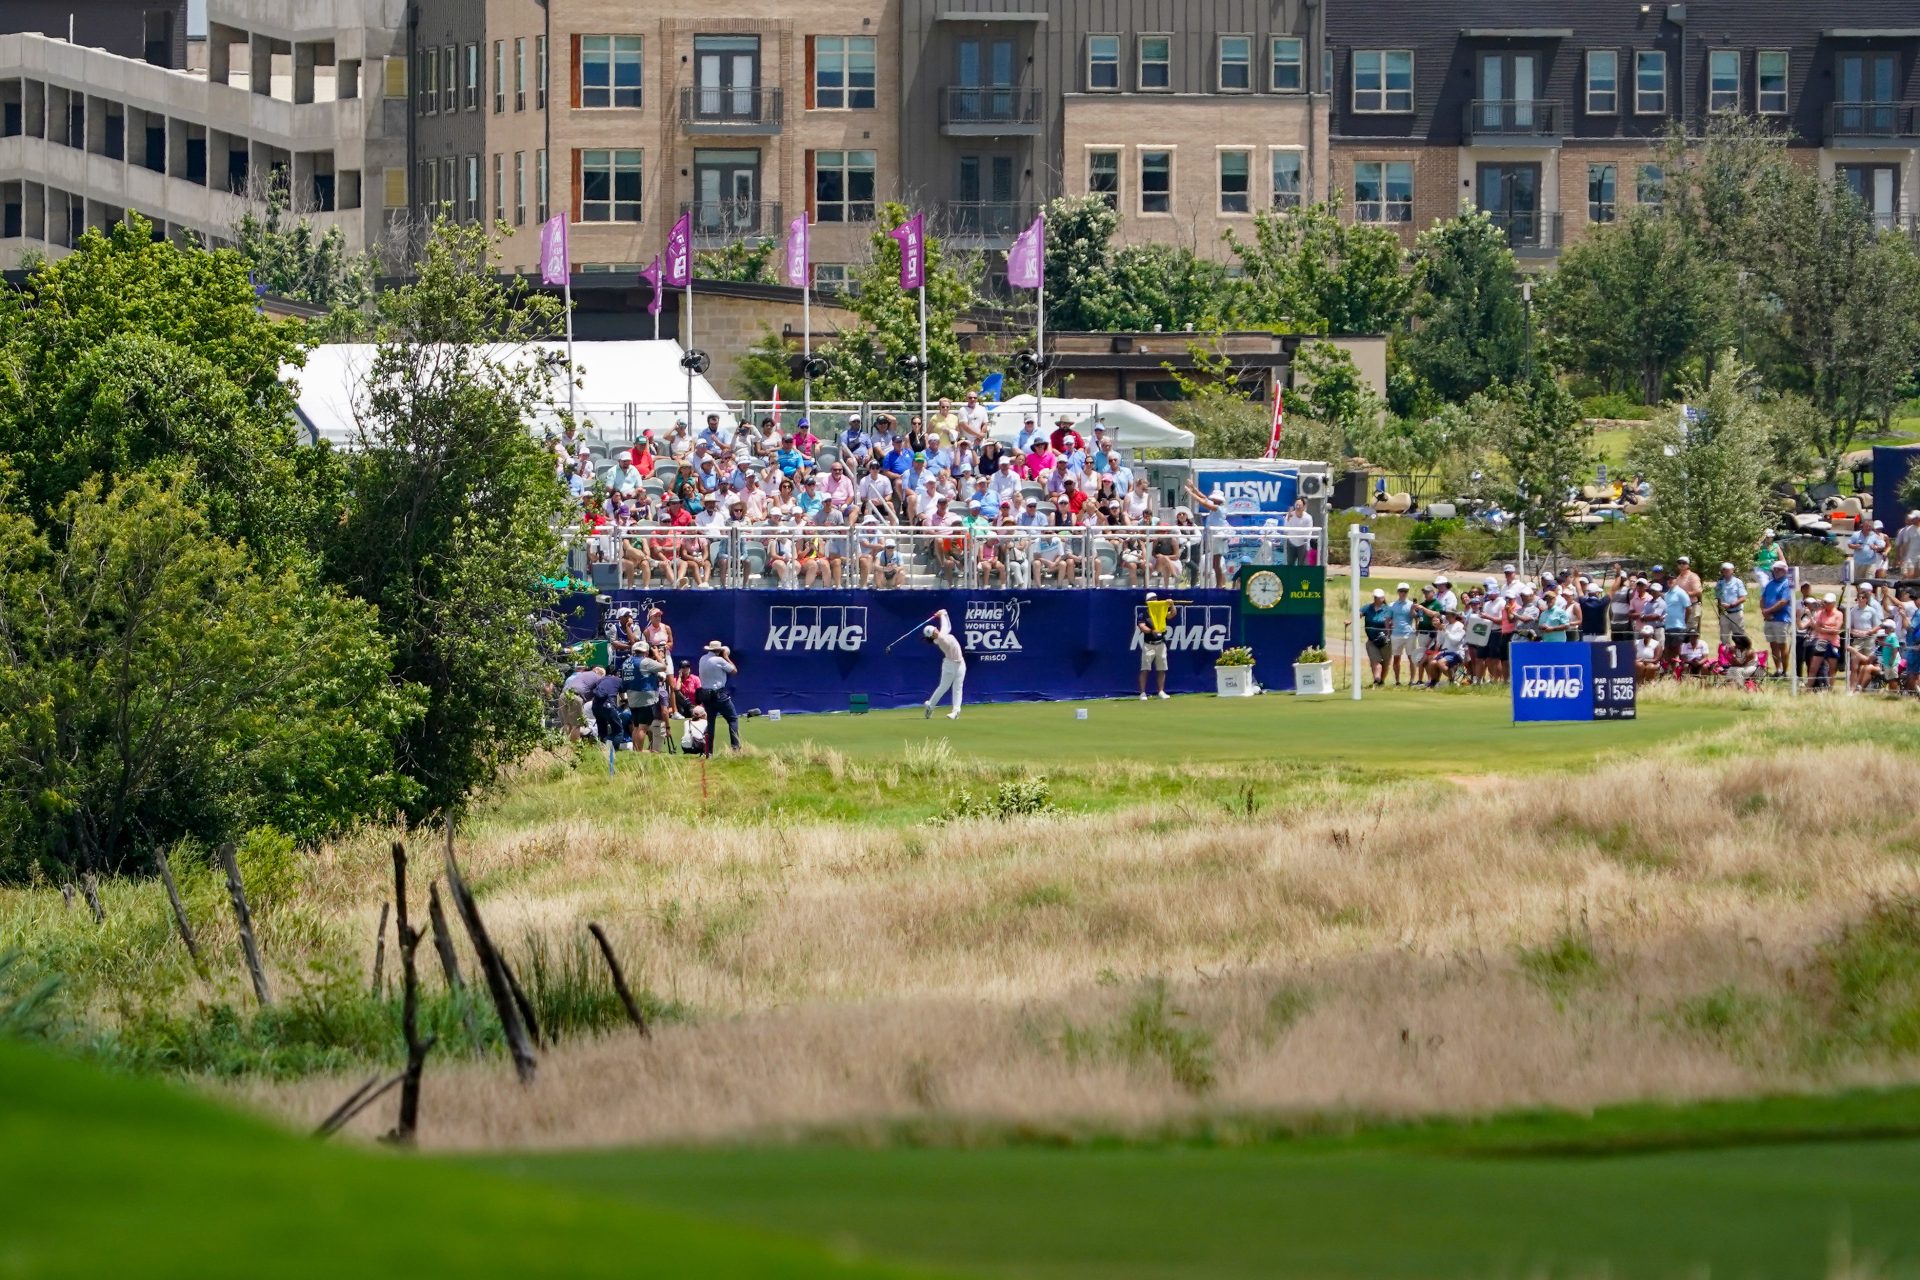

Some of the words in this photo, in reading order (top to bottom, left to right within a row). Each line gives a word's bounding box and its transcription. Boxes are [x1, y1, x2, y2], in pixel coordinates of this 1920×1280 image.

[1290, 591, 1321, 599] ROLEX
[965, 608, 1003, 620] KPMG
[964, 622, 1005, 630] WOMEN'S
[764, 625, 864, 651] KPMG
[964, 630, 1023, 650] PGA
[980, 653, 1007, 662] FRISCO
[1607, 644, 1618, 669] 1
[1521, 678, 1581, 698] KPMG
[1597, 685, 1606, 701] 5
[1612, 684, 1634, 701] 526
